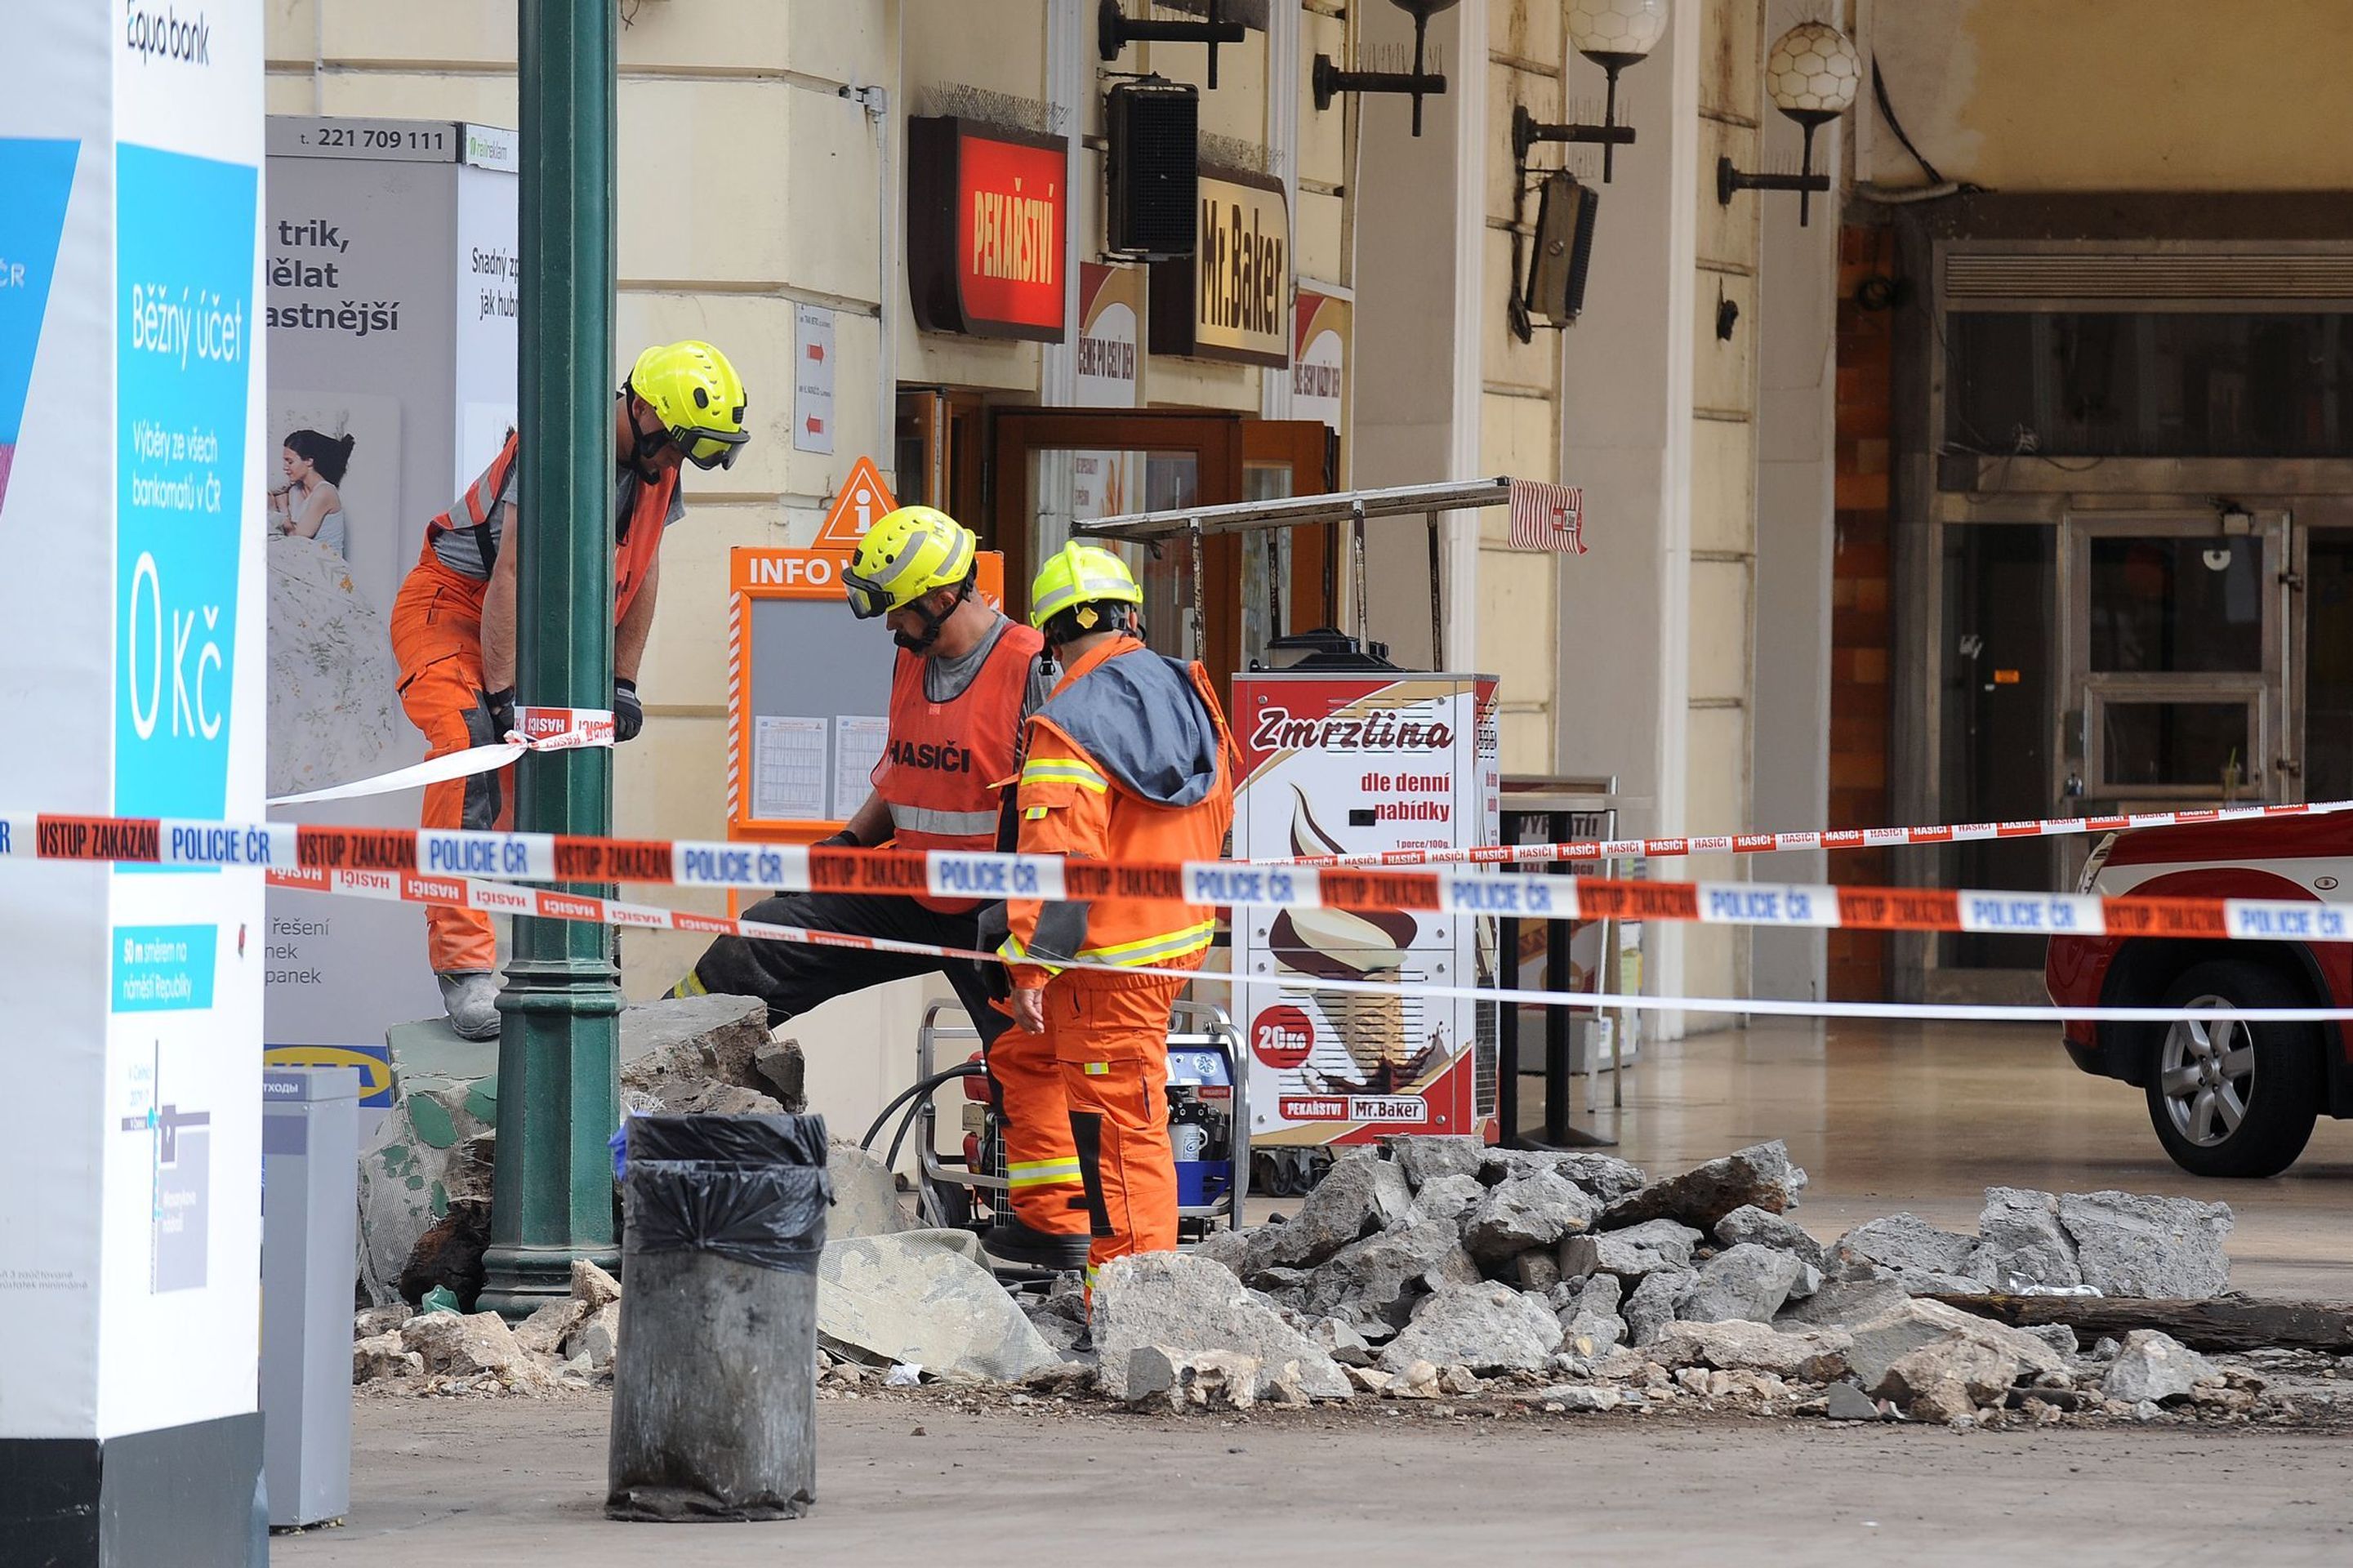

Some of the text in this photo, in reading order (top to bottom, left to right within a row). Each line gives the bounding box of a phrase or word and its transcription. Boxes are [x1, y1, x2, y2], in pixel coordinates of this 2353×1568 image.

[170, 4, 209, 66] bank
[318, 128, 355, 147] 221
[363, 130, 402, 148] 709
[408, 132, 443, 150] 111
[279, 219, 350, 254] trik,
[974, 176, 1054, 286] PEKAŘSTVÍ
[472, 247, 507, 283] Snadný
[1201, 198, 1284, 336] Mr.Baker
[479, 287, 495, 321] jak
[132, 282, 243, 372] Běžný účet
[132, 419, 218, 467] Výběry ze všech
[132, 468, 194, 511] bankomatů
[750, 558, 831, 585] INFO
[129, 551, 222, 741] 0 Kč
[1250, 708, 1455, 750] Zmrzlina
[889, 738, 970, 773] HASIČI
[1361, 772, 1450, 792] dle denní
[1375, 801, 1450, 822] nabídky
[39, 822, 87, 857] VSTUP
[92, 819, 159, 860] ZAKÁZÁN
[172, 827, 240, 862] POLICIE
[246, 824, 271, 864] ČR
[298, 832, 345, 866] VSTUP
[352, 830, 417, 870] ZAKÁZÁN
[430, 838, 497, 872] POLICIE
[503, 835, 528, 874] ČR
[684, 848, 752, 883] POLICIE
[758, 844, 784, 884] ČR
[940, 861, 1007, 893] POLICIE
[1388, 851, 1420, 865] HASIČI
[1432, 849, 1464, 863] HASIČI
[1475, 847, 1508, 862] HASIČI
[1518, 845, 1552, 858] HASIČI
[1562, 843, 1595, 856] HASIČI
[340, 870, 390, 889] HASIČI
[408, 880, 460, 899] HASIČI
[476, 890, 527, 908] HASIČI
[273, 917, 330, 936] řešení
[1355, 1101, 1419, 1118] Mr.Baker
